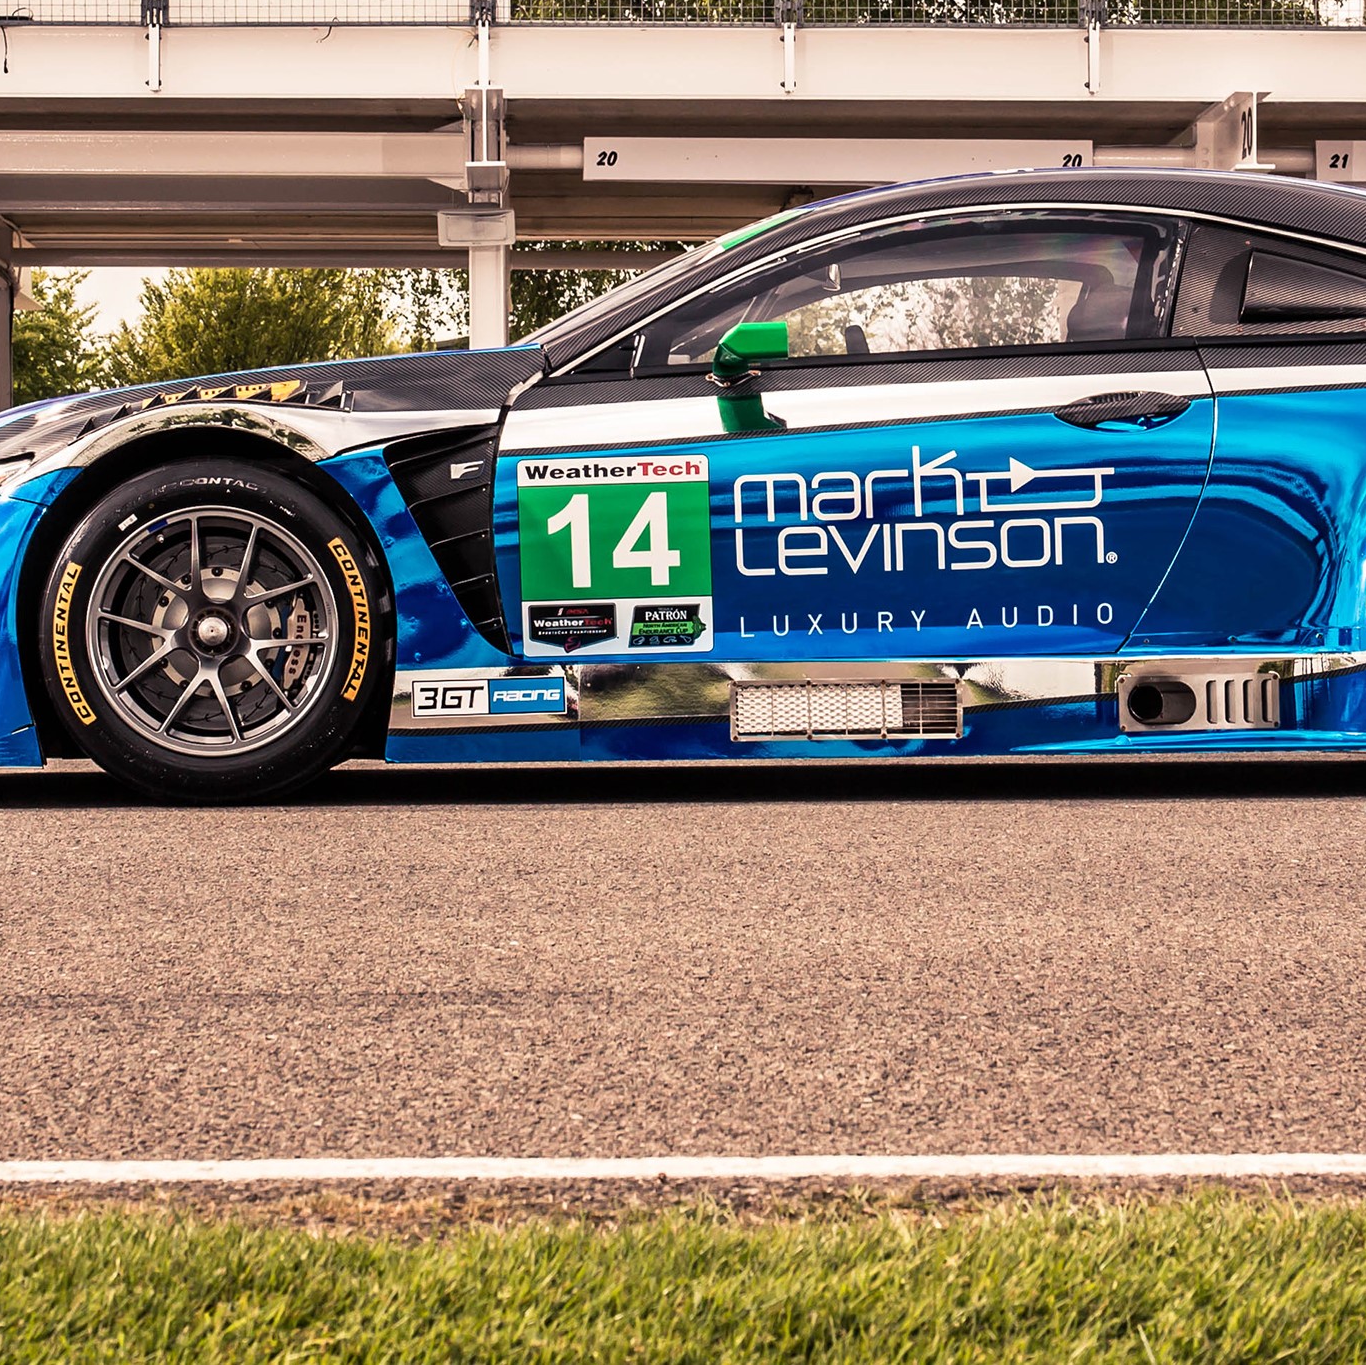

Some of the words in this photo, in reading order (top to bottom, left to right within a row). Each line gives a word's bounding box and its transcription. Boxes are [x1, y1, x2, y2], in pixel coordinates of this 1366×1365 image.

[1241, 107, 1253, 160] 20
[596, 150, 618, 167] 20
[1062, 153, 1083, 168] 20
[1329, 153, 1349, 169] 21
[525, 461, 701, 480] WeatherTech
[547, 491, 681, 588] 14
[332, 544, 368, 695] CONTINENTAL
[645, 609, 688, 621] PATRÓN
[740, 610, 926, 637] LUXURY
[966, 602, 1113, 629] AUDIO
[55, 568, 92, 720] CONTINENTAL
[418, 686, 484, 710] 3GT
